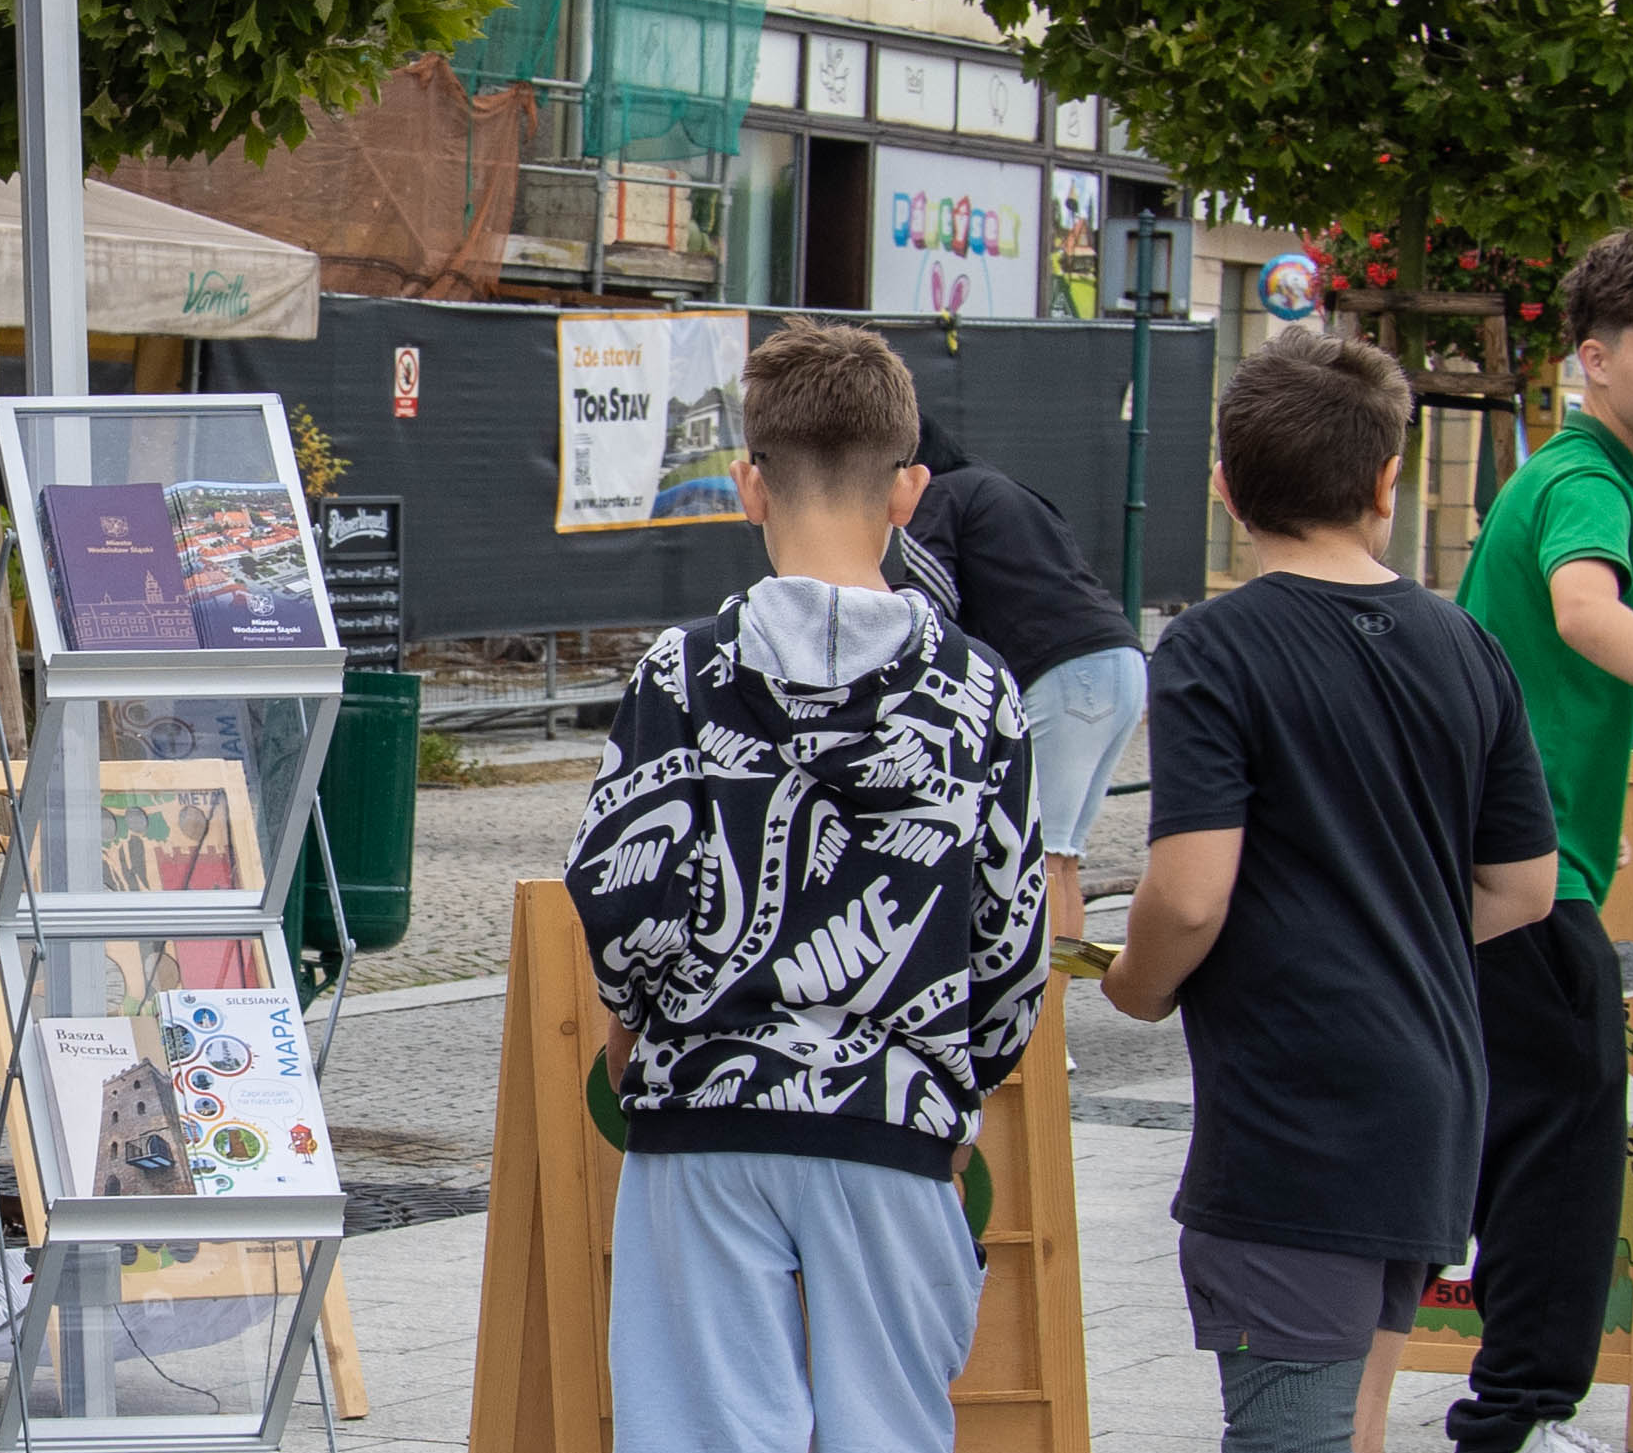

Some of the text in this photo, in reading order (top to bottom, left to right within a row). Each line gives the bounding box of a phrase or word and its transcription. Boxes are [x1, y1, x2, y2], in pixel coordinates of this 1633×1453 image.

[182, 270, 251, 318] Vanilla
[574, 343, 643, 368] Zde staví
[87, 545, 154, 555] Wodzisław Śląski
[105, 539, 133, 547] Miasto
[232, 624, 302, 635] Wodzisław Śląski
[251, 618, 280, 626] Miasto
[697, 720, 773, 773] NIKE
[811, 819, 852, 886] NIKE
[861, 817, 954, 867] NIKE
[591, 836, 670, 896] NIKE
[773, 875, 899, 1004] NIKE
[225, 996, 290, 1007] SILESIANKA
[56, 1028, 105, 1042] Baszta
[269, 1008, 302, 1077] MAPA
[59, 1042, 130, 1057] Rycerska
[240, 1089, 290, 1099] Zapraszam
[1435, 1284, 1472, 1305] 50
